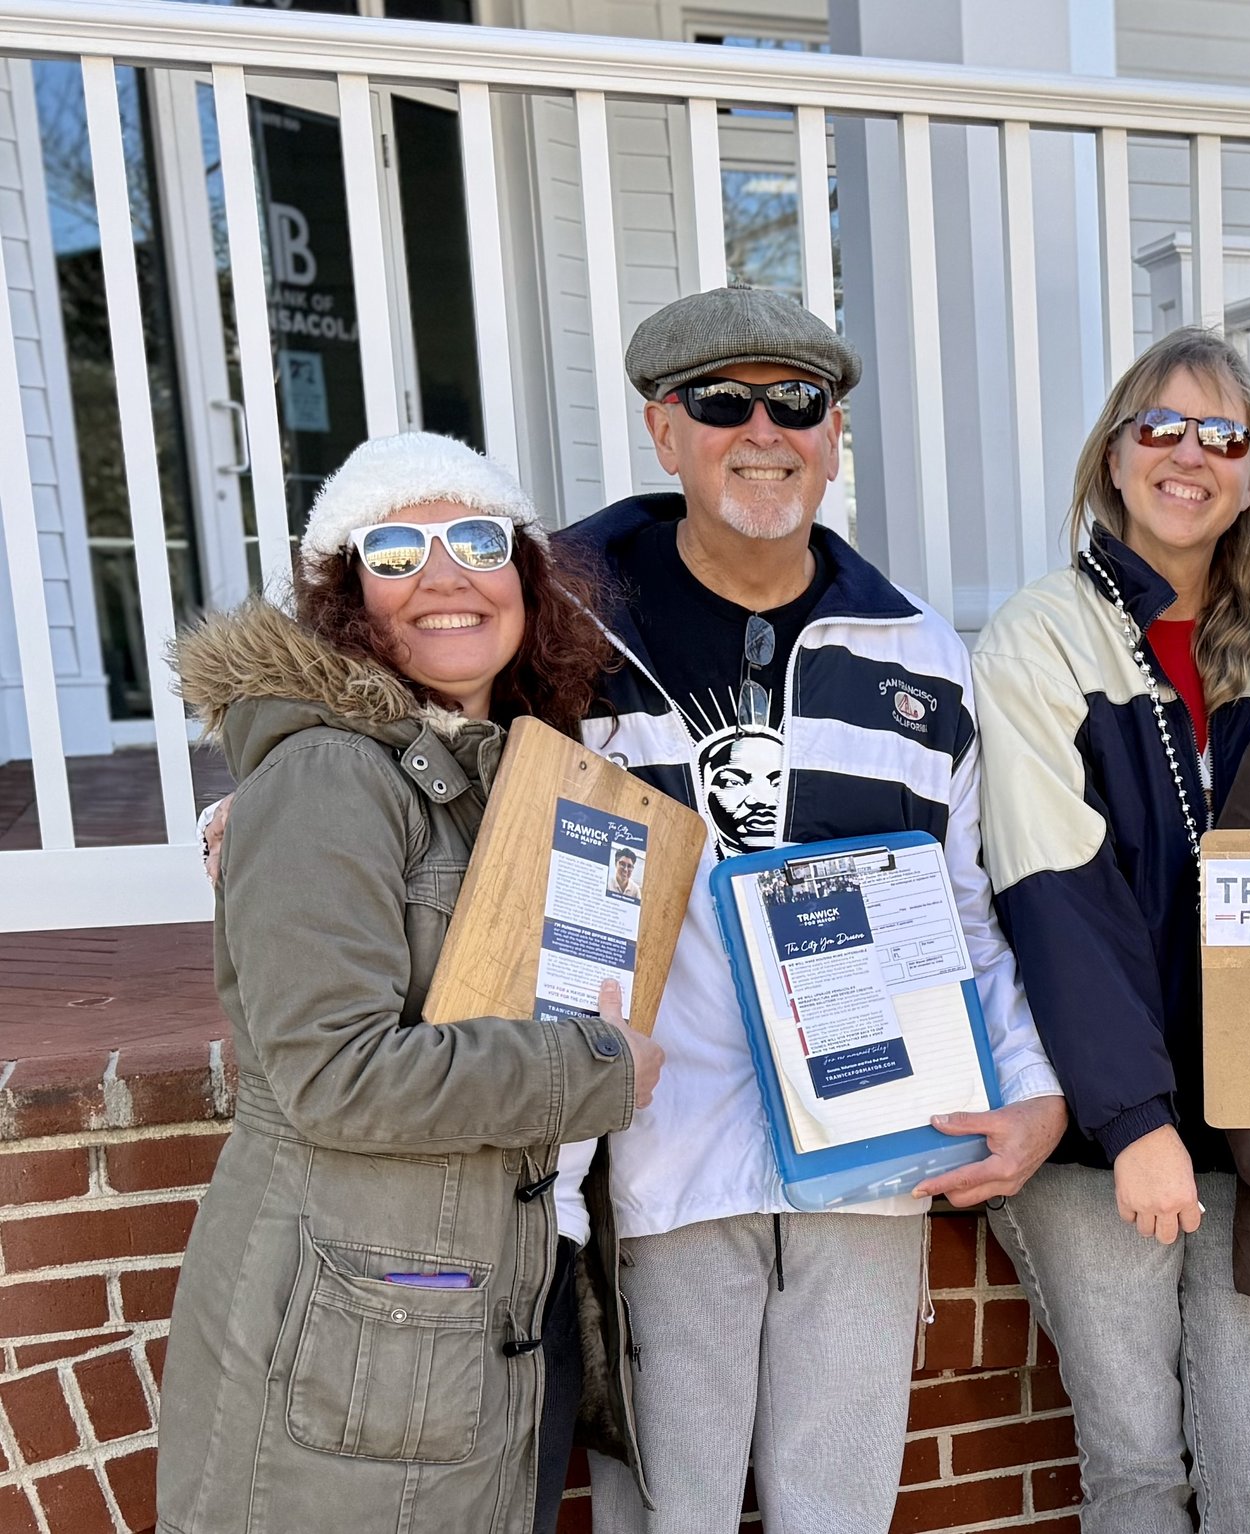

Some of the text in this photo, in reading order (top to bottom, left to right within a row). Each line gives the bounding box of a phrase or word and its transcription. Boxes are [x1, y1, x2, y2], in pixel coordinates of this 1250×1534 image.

[311, 293, 335, 312] OF
[878, 678, 937, 712] SAN FRANCISCO
[561, 818, 609, 843] TRAWICK
[566, 830, 579, 840] FOR
[580, 834, 602, 847] MAYOR
[797, 907, 840, 923] TRAWICK
[816, 916, 836, 925] MAYOR
[784, 942, 799, 955] The
[801, 940, 818, 953] City
[820, 937, 835, 952] You
[826, 1061, 896, 1082] TRAWICKFORMAYOR.COM
